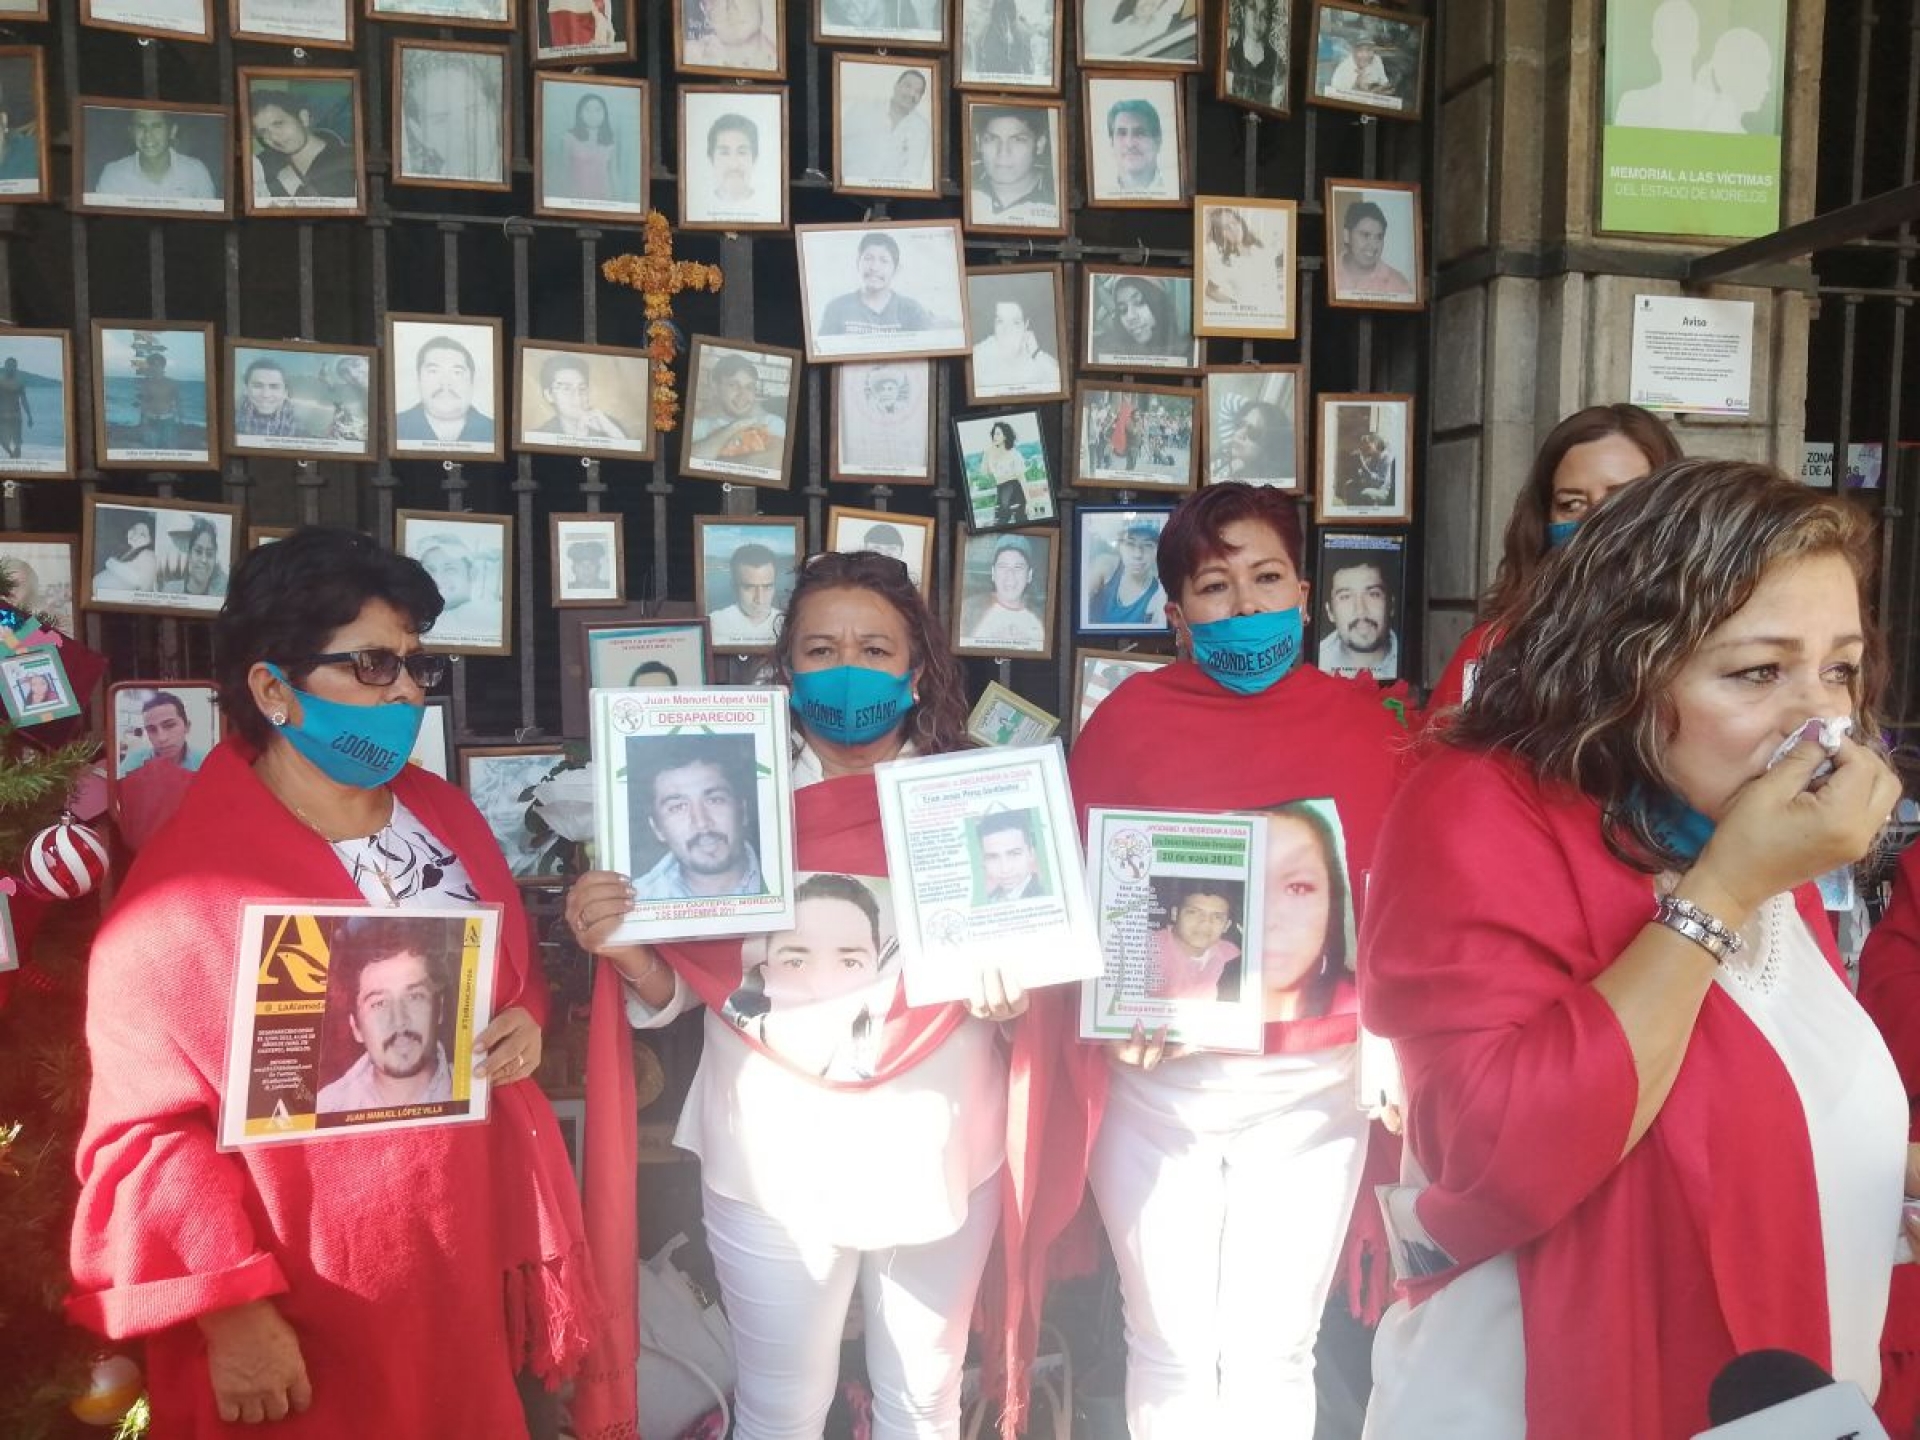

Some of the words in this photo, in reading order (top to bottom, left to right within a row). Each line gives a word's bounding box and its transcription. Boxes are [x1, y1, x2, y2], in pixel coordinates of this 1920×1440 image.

[1610, 165, 1675, 182] MEMORIAL
[1678, 171, 1687, 183] A
[1689, 171, 1714, 184] LAS
[1717, 170, 1774, 188] VÍCTIMAS
[1615, 183, 1638, 196] DEL
[1641, 184, 1689, 199] ESTADO
[1691, 187, 1708, 201] DE
[1710, 188, 1768, 204] MORELOS
[1682, 316, 1708, 327] Aviso
[644, 696, 670, 705] Juan
[673, 694, 711, 705] Manuel
[713, 694, 744, 707] López
[746, 694, 769, 705] Villa
[658, 711, 755, 724] DESAPARECIDO
[332, 730, 400, 772] ¿DÓNDE
[345, 1113, 366, 1123] JUAN
[366, 1109, 398, 1121] MANUEL
[398, 1107, 422, 1118] LÓPEZ
[422, 1105, 443, 1115] VILLA
